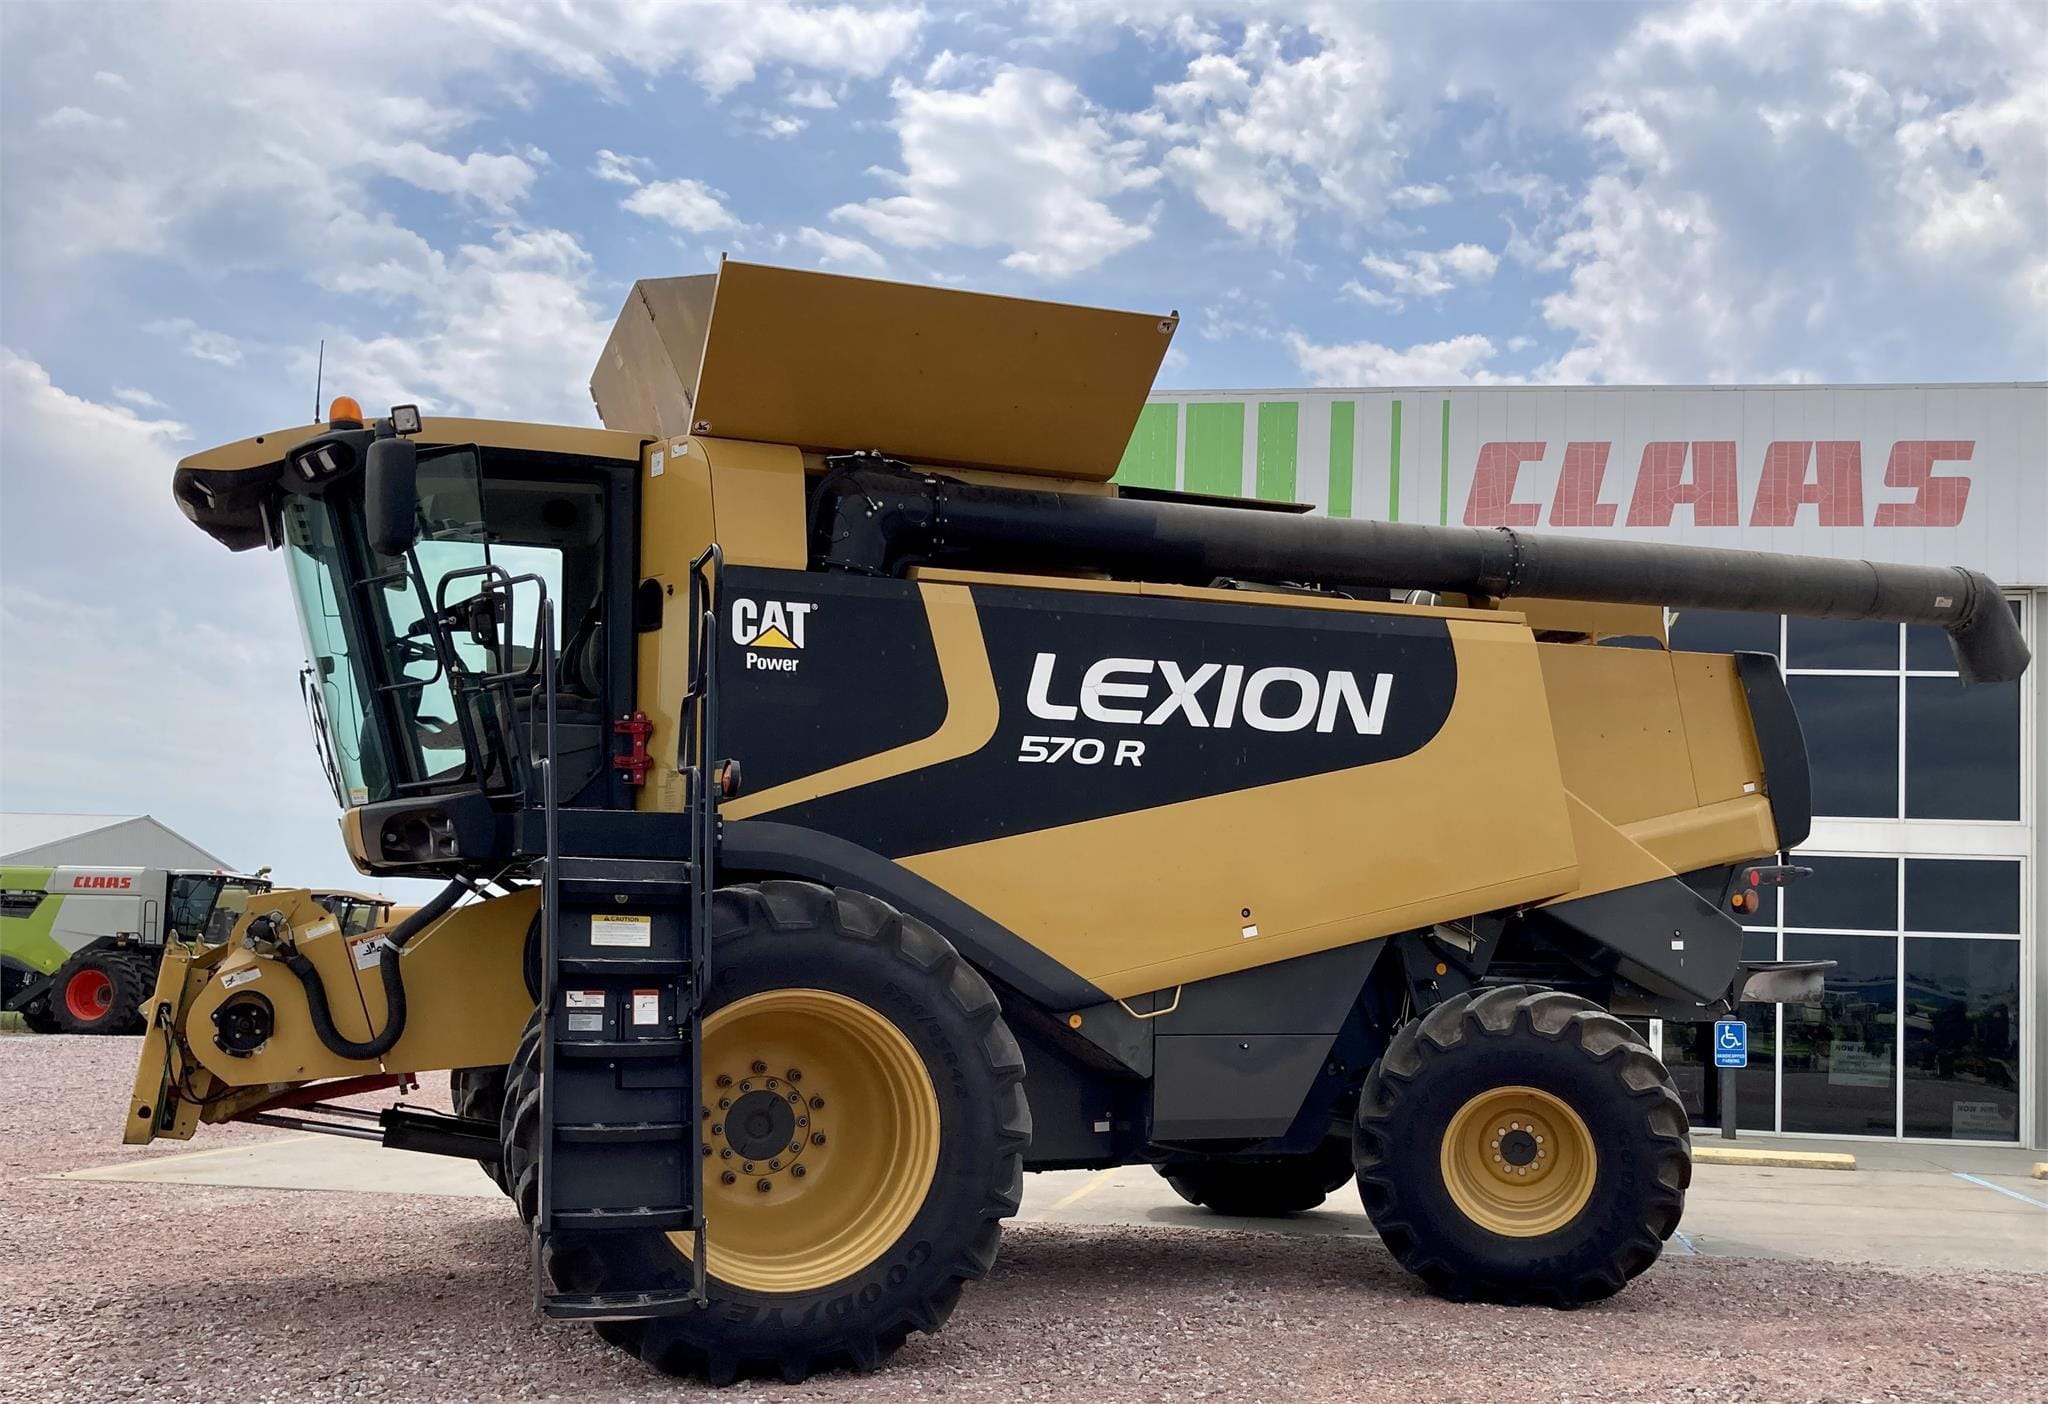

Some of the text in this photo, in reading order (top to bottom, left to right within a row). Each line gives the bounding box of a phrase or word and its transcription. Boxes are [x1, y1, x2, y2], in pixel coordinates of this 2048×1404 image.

[1462, 440, 1976, 527] CLAAS
[732, 598, 810, 649] CAT
[746, 652, 799, 671] Power
[1026, 652, 1393, 735] LEXION
[1018, 735, 1146, 767] 570 R
[73, 876, 132, 889] CLAAS
